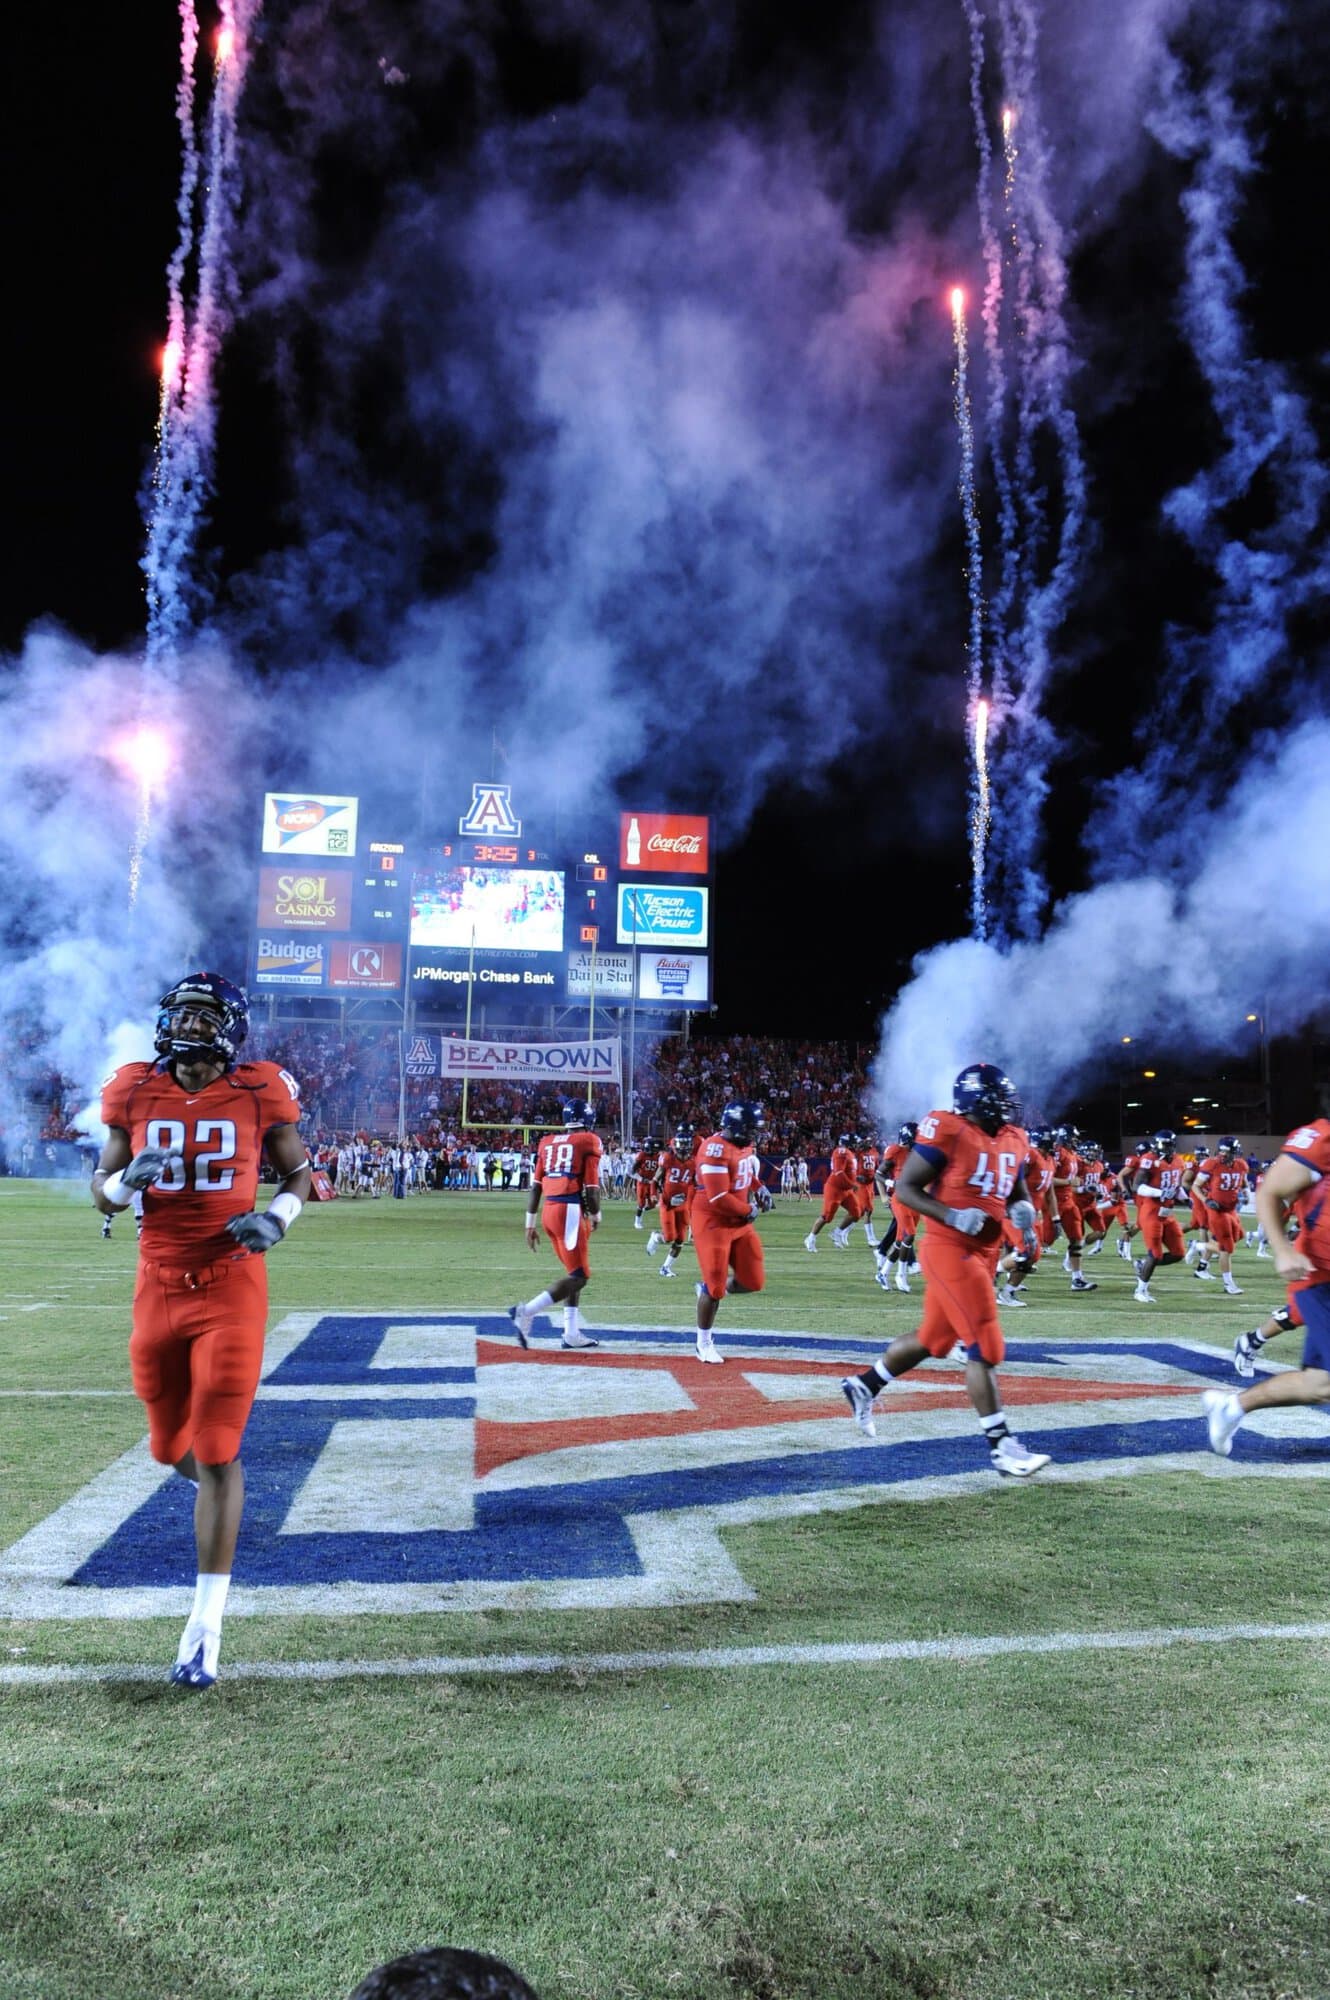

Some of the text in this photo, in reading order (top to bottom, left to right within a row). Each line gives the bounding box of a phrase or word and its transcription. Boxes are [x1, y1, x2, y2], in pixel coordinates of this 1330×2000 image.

[459, 783, 521, 838] A
[443, 845, 452, 857] 3
[473, 845, 518, 863] 3:25
[527, 850, 536, 861] 3
[275, 875, 336, 904] SOL
[642, 892, 685, 906] Tucson
[275, 902, 336, 918] CASINOS
[646, 905, 696, 918] Electric
[651, 916, 695, 929] Power
[258, 938, 323, 963] Budget
[413, 967, 555, 984] JPMorgan Chase Bank
[568, 969, 603, 984] Daiy
[406, 1035, 437, 1064] A
[448, 1044, 612, 1068] BEAR DOWN
[406, 1065, 436, 1075] CLUB
[146, 1119, 236, 1192] 82
[544, 1143, 574, 1174] 18
[705, 1142, 725, 1158] 95
[669, 1167, 691, 1184] 24
[967, 1151, 1008, 1200] 46
[1219, 1172, 1241, 1192] 37
